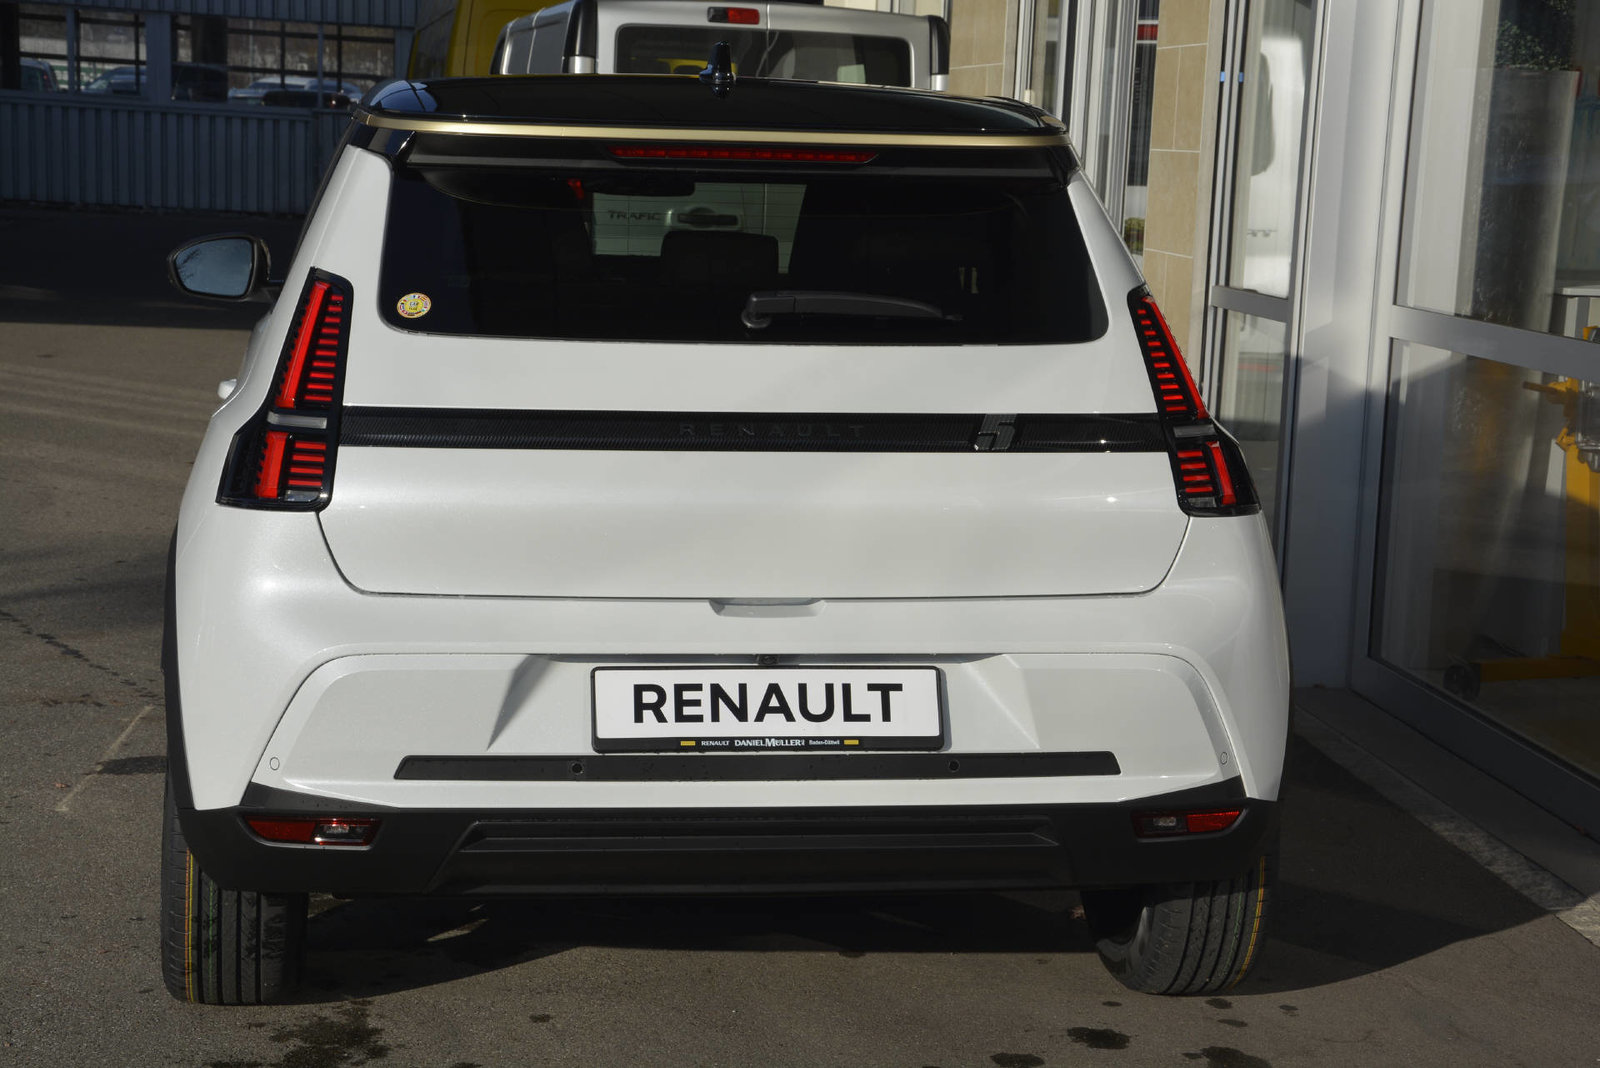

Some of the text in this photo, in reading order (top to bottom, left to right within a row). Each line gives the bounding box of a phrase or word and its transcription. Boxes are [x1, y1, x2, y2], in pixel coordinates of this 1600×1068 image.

[608, 210, 662, 220] TRAFIC
[679, 422, 866, 438] RENAULT
[633, 683, 903, 724] RENAULT
